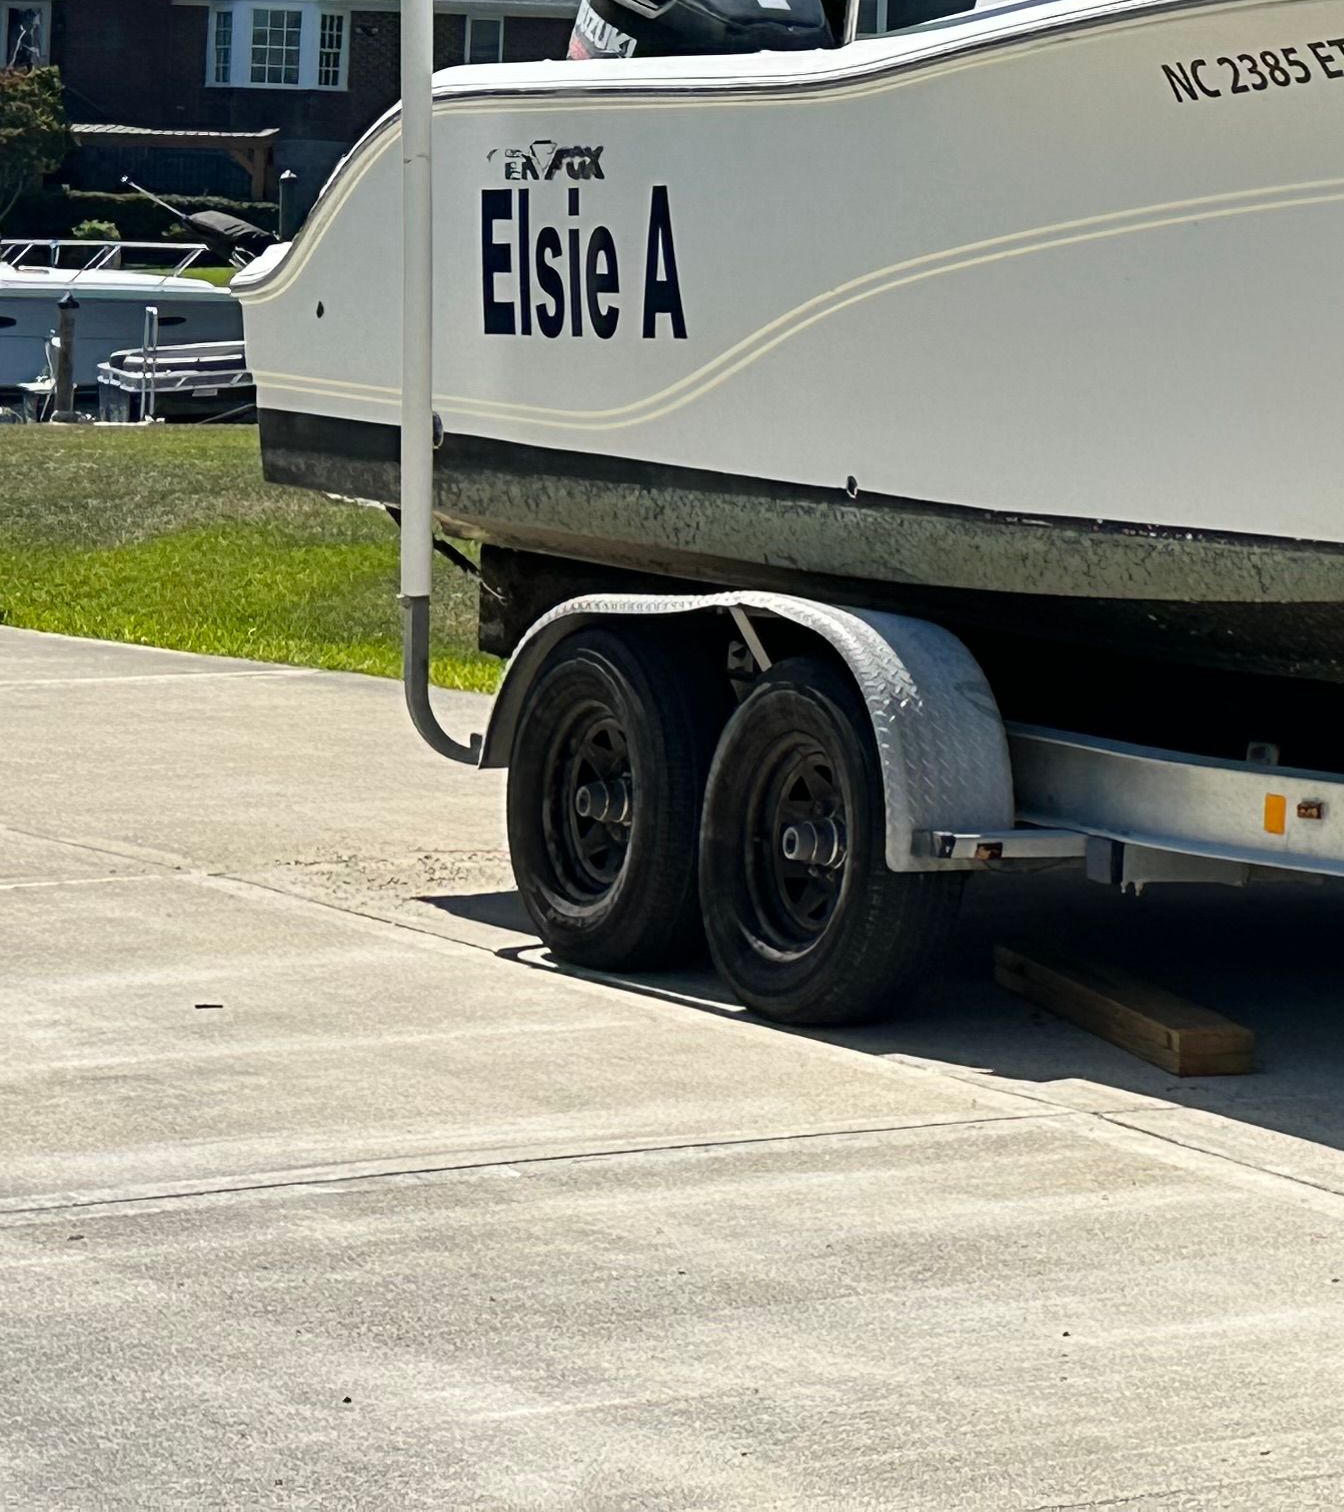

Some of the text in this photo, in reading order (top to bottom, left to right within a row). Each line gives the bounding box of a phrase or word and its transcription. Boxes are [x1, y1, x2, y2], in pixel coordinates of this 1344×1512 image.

[1161, 58, 1222, 104] NC
[1216, 46, 1312, 95] 2385
[481, 184, 688, 340] Elsie A
